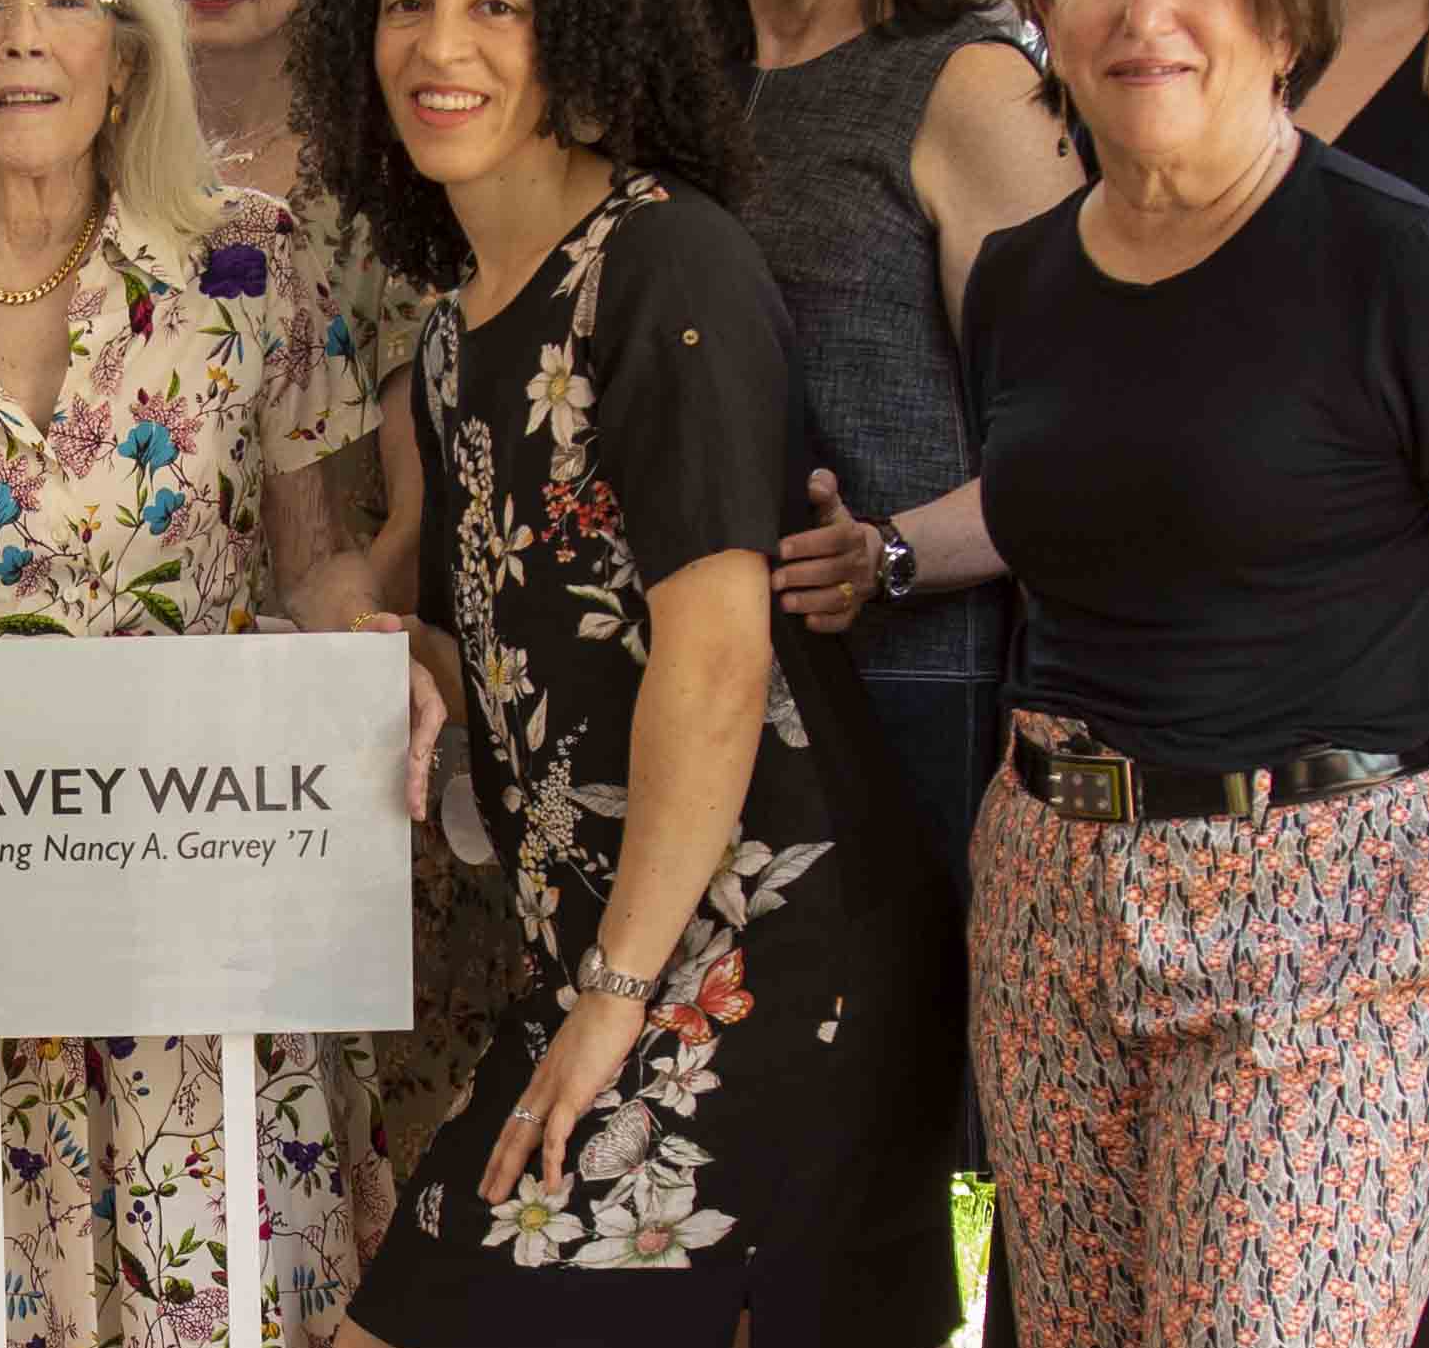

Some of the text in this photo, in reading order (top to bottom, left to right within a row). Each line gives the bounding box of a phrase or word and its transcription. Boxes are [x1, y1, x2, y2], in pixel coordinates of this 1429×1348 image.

[138, 764, 332, 814] WALK
[43, 833, 136, 869] Nancy
[141, 832, 168, 860] A.
[177, 831, 276, 867] Garvey
